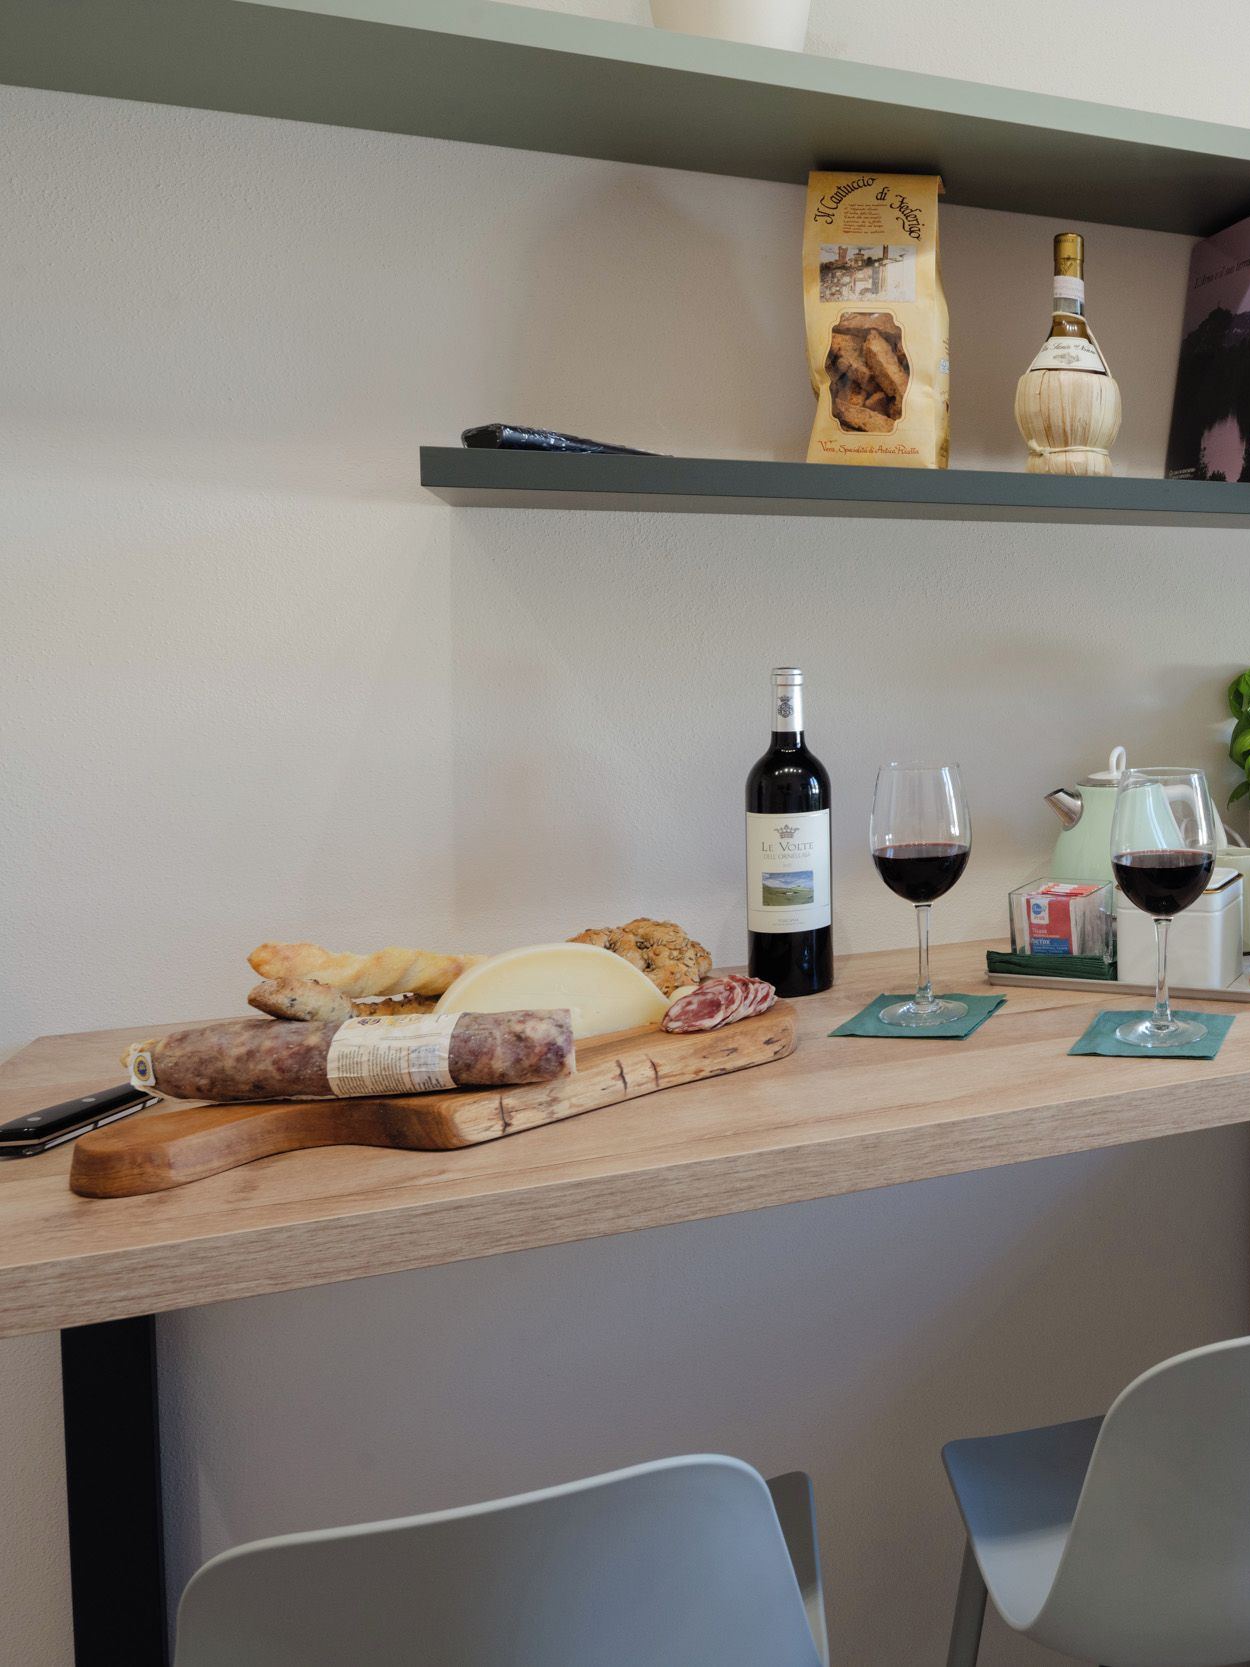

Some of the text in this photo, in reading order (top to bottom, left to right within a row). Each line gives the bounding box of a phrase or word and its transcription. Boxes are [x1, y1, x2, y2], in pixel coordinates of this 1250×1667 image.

[819, 176, 878, 210] Cantuccio
[875, 186, 891, 201] di
[889, 194, 926, 242] Federigo
[779, 841, 815, 852] VOLTE
